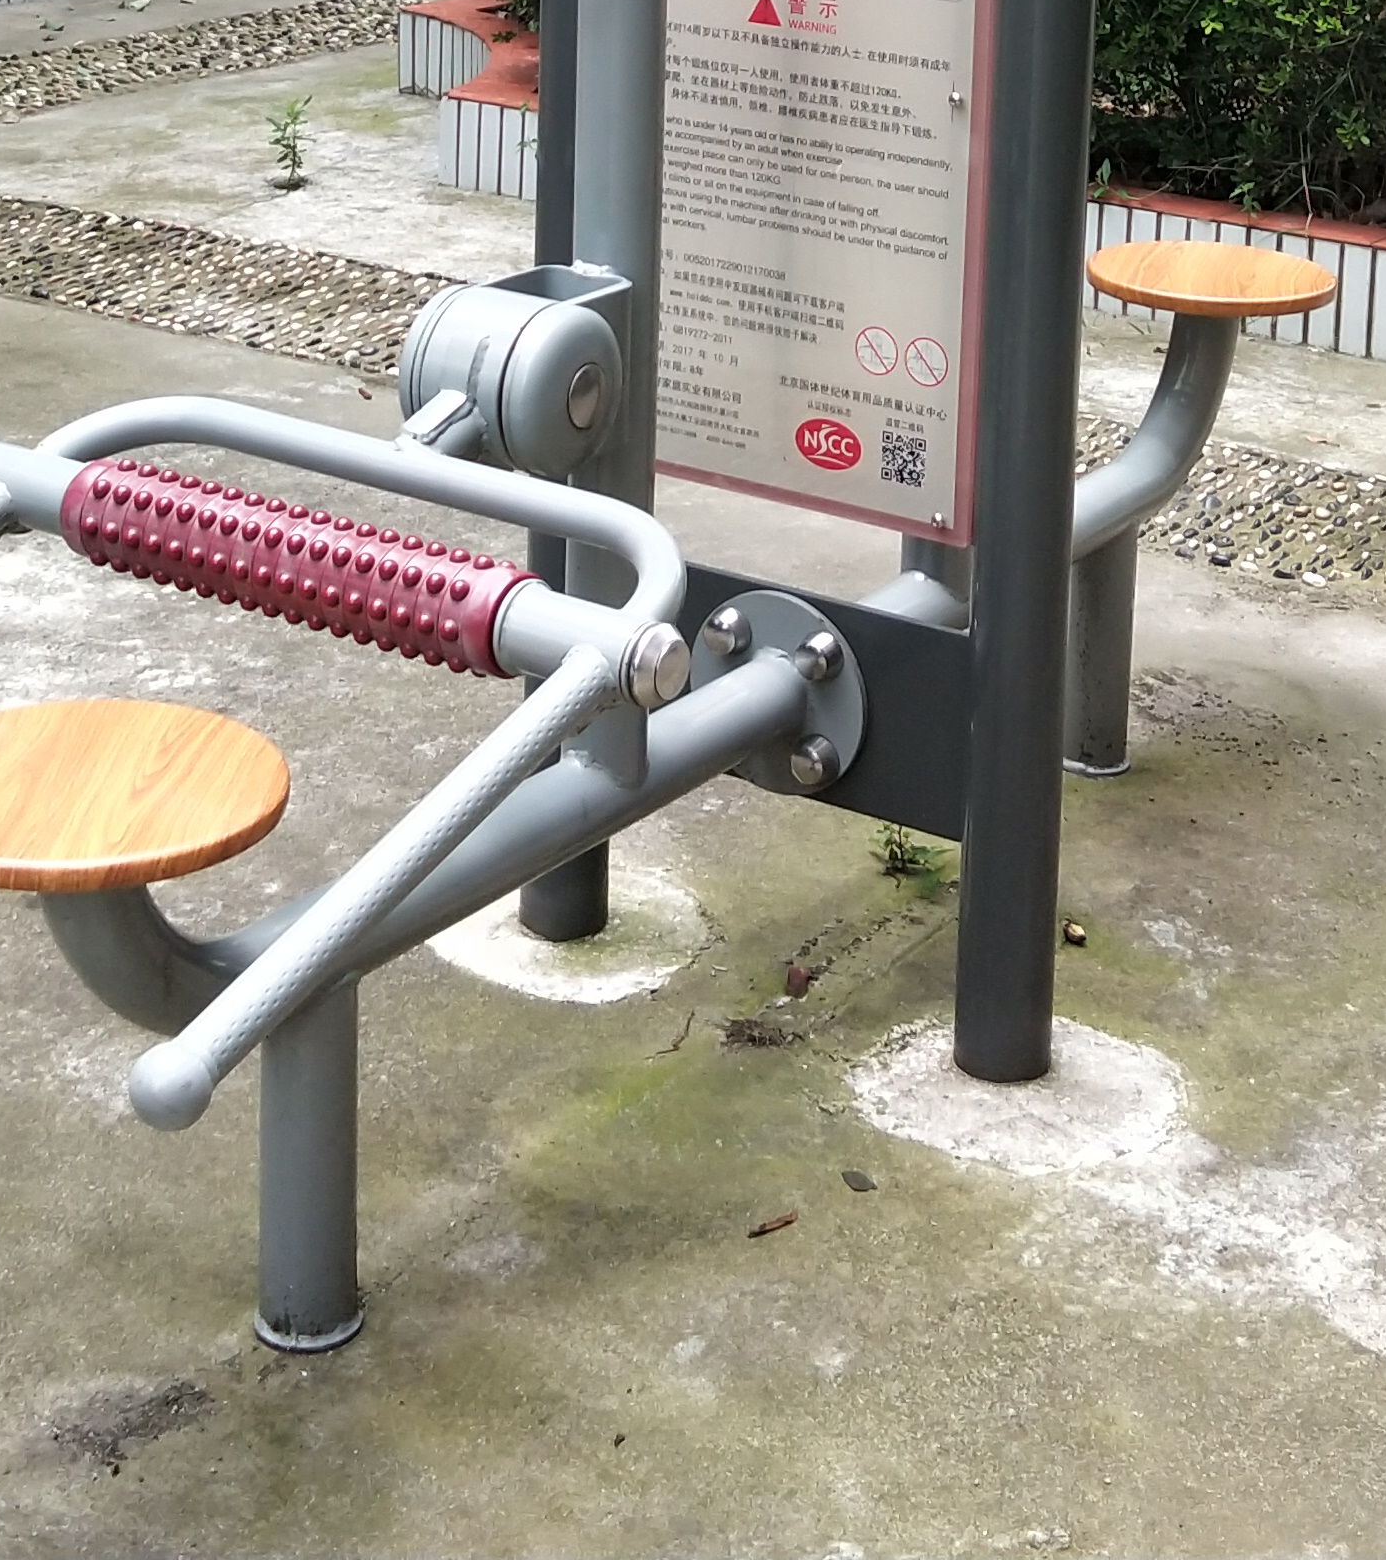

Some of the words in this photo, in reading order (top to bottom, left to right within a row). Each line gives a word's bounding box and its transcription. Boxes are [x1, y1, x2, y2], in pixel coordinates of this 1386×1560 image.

[788, 19, 837, 34] WARNING
[674, 130, 730, 147] accompanied
[732, 139, 743, 151] by
[744, 142, 755, 151] an
[757, 144, 779, 155] adult
[780, 148, 804, 159] when
[693, 120, 716, 131] under
[718, 122, 728, 132] 14
[730, 126, 753, 137] years
[754, 129, 767, 139] old
[768, 132, 777, 140] or
[779, 133, 795, 144] has
[796, 137, 807, 146] no
[809, 139, 833, 152] ability
[835, 142, 844, 151] to
[845, 146, 885, 161] operating
[668, 159, 703, 172] weighed
[704, 165, 727, 176] more
[729, 168, 748, 179] than
[751, 172, 782, 185] 120KG
[728, 154, 744, 163] can
[746, 157, 765, 170] only
[767, 160, 779, 170] be
[781, 162, 803, 175] used
[805, 166, 817, 176] for
[820, 169, 837, 180] one
[876, 178, 892, 190] the
[894, 183, 915, 194] user
[917, 186, 949, 200] should
[689, 192, 713, 205] using
[714, 195, 729, 205] the
[730, 196, 767, 212] machine
[769, 205, 790, 217] after
[791, 209, 826, 226] drinking
[828, 216, 837, 225] or
[840, 219, 858, 229] with
[860, 221, 897, 236] physical
[693, 176, 702, 186] or
[704, 177, 714, 188] sit
[715, 180, 727, 190] on
[729, 183, 743, 194] the
[745, 186, 791, 202] equipment
[792, 194, 801, 204] in
[803, 197, 825, 208] case
[826, 200, 836, 210] of
[838, 201, 864, 217] falling
[670, 203, 687, 213] with
[726, 211, 757, 225] lumbar
[758, 218, 800, 234] problems
[801, 226, 832, 239] should
[834, 231, 846, 241] be
[847, 234, 874, 246] under
[876, 239, 891, 249] the
[894, 243, 936, 259] guidance
[938, 250, 948, 260] of
[713, 353, 724, 363] 10
[729, 354, 739, 368] 月
[803, 423, 854, 457] NSCC
